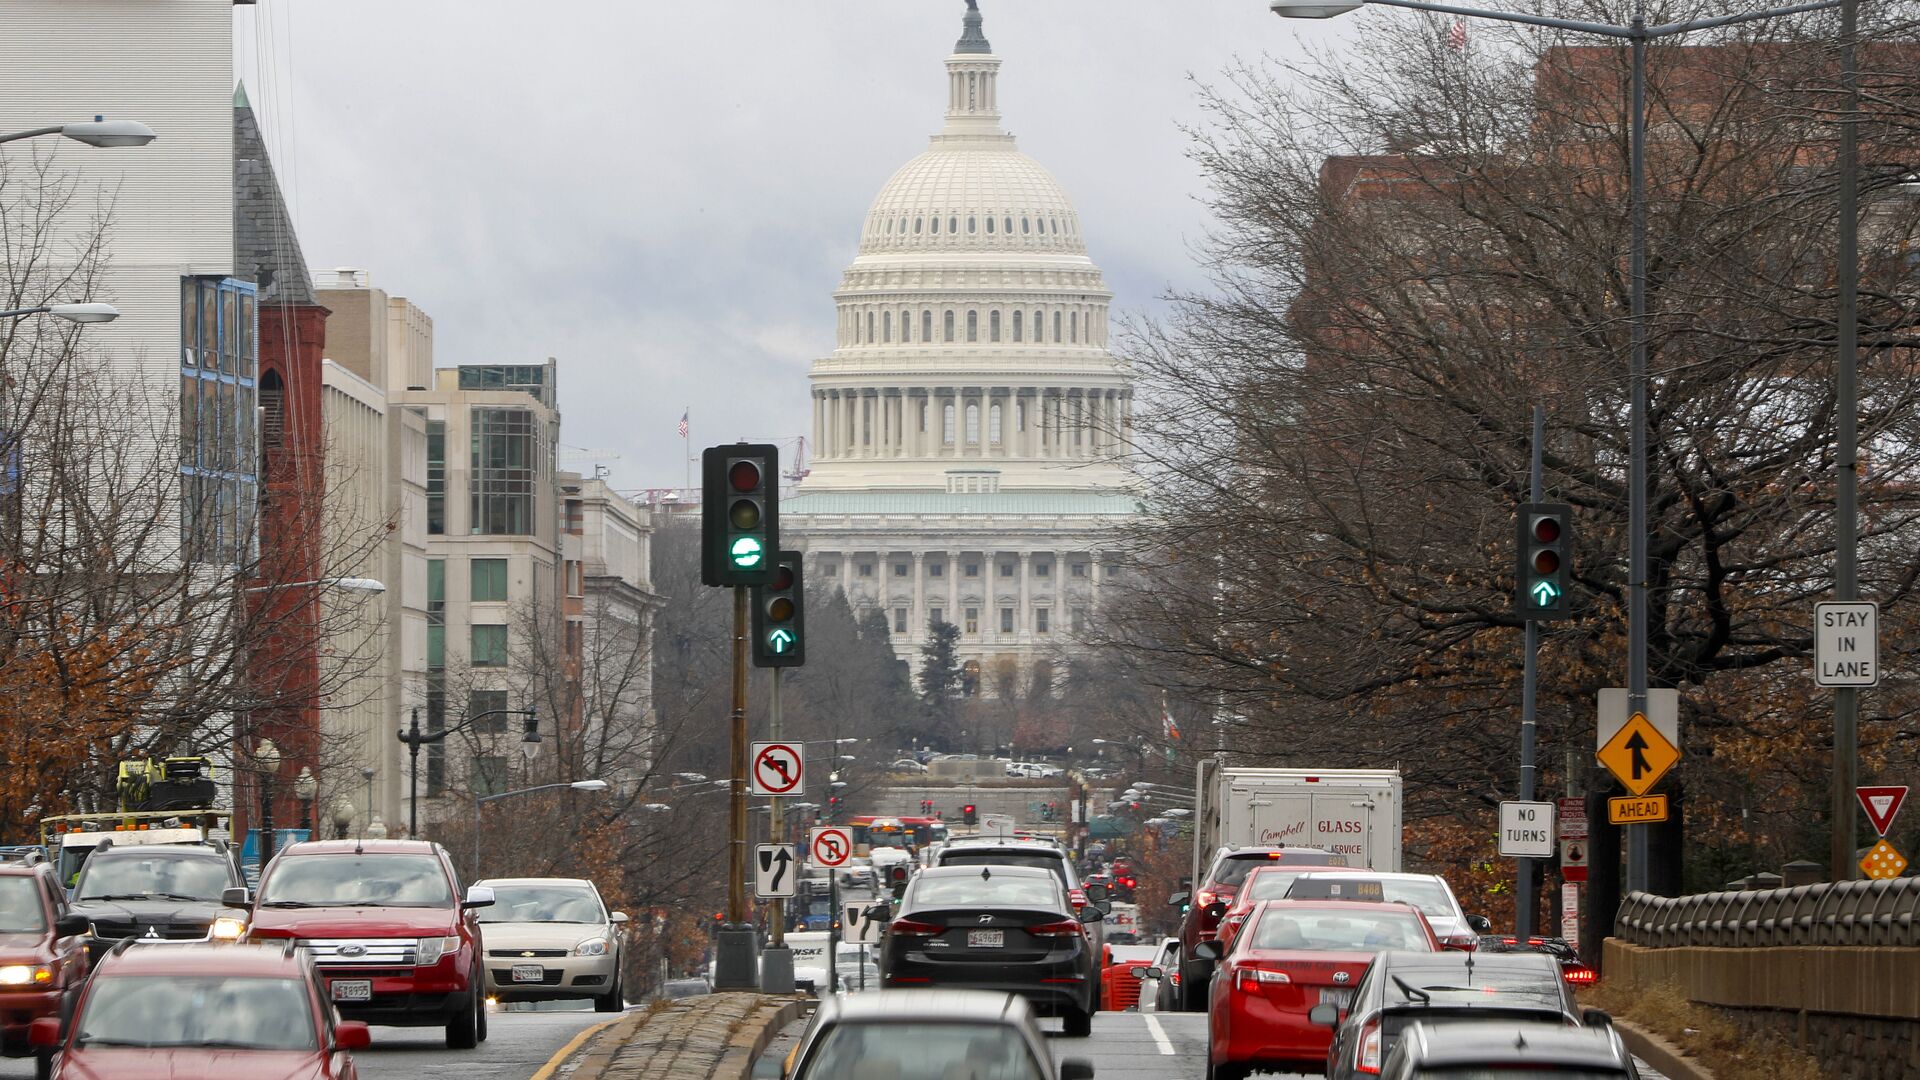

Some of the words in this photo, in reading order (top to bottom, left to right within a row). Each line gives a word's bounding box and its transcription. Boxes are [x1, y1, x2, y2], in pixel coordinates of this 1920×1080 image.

[1824, 612, 1869, 627] STAY
[1838, 637, 1855, 652] IN
[1823, 662, 1870, 677] LANE
[1518, 809, 1535, 822] NO
[1619, 802, 1659, 817] AHEAD
[1260, 822, 1305, 843] Campbell
[1318, 821, 1362, 833] GLASS
[1506, 829, 1547, 842] TURNS
[1333, 844, 1362, 854] ERVICE
[1104, 913, 1134, 925] edEx
[793, 948, 824, 956] NSKE
